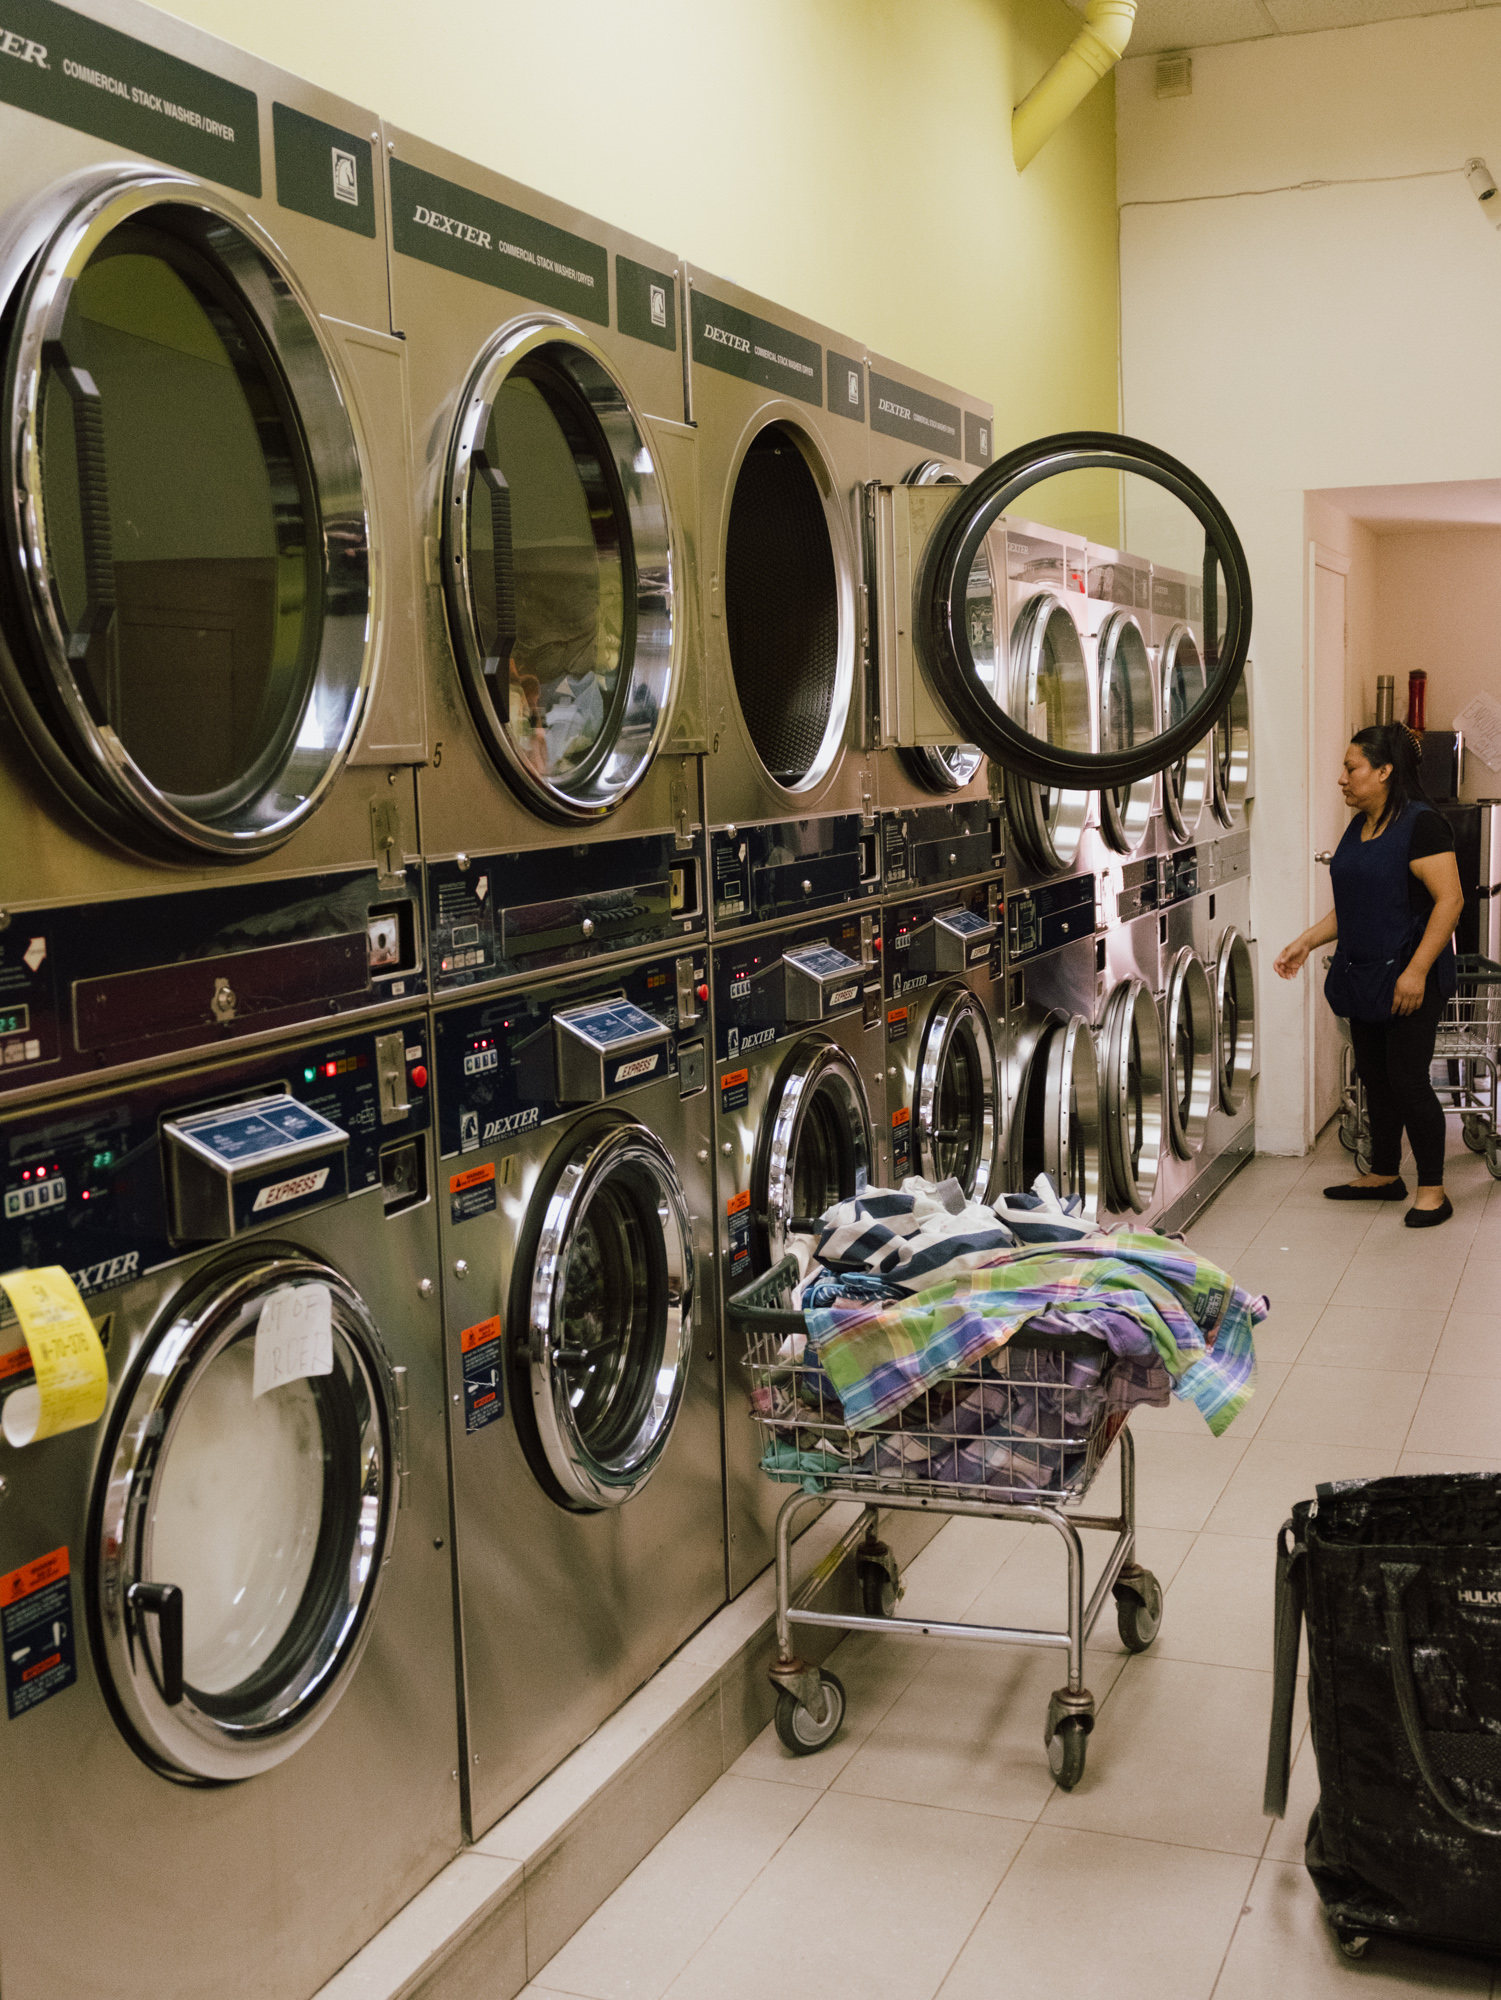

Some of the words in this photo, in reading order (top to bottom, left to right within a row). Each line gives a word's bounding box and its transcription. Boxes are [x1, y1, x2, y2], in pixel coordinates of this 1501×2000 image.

[62, 58, 130, 100] COMMERCIAL
[131, 86, 163, 113] STACK
[163, 99, 235, 143] WASHER/DRYER
[412, 204, 492, 250] DEXTER
[498, 239, 536, 265] COMMERCIAL
[536, 254, 554, 272] STACK
[553, 261, 595, 288] WASHER/DRYER
[703, 323, 751, 354] DEXTER
[878, 398, 911, 420] DEXTER
[433, 742, 443, 769] 5
[713, 732, 720, 754] 6
[902, 974, 928, 993] DEXTER
[741, 1027, 776, 1051] DEXTER
[621, 1057, 652, 1079] EXPRESS
[482, 1107, 539, 1140] DEXTER
[482, 1131, 516, 1146] COMMERCIAL
[517, 1122, 538, 1134] WASHER
[265, 1174, 318, 1205] EXPRESS
[69, 1250, 140, 1291] XTER
